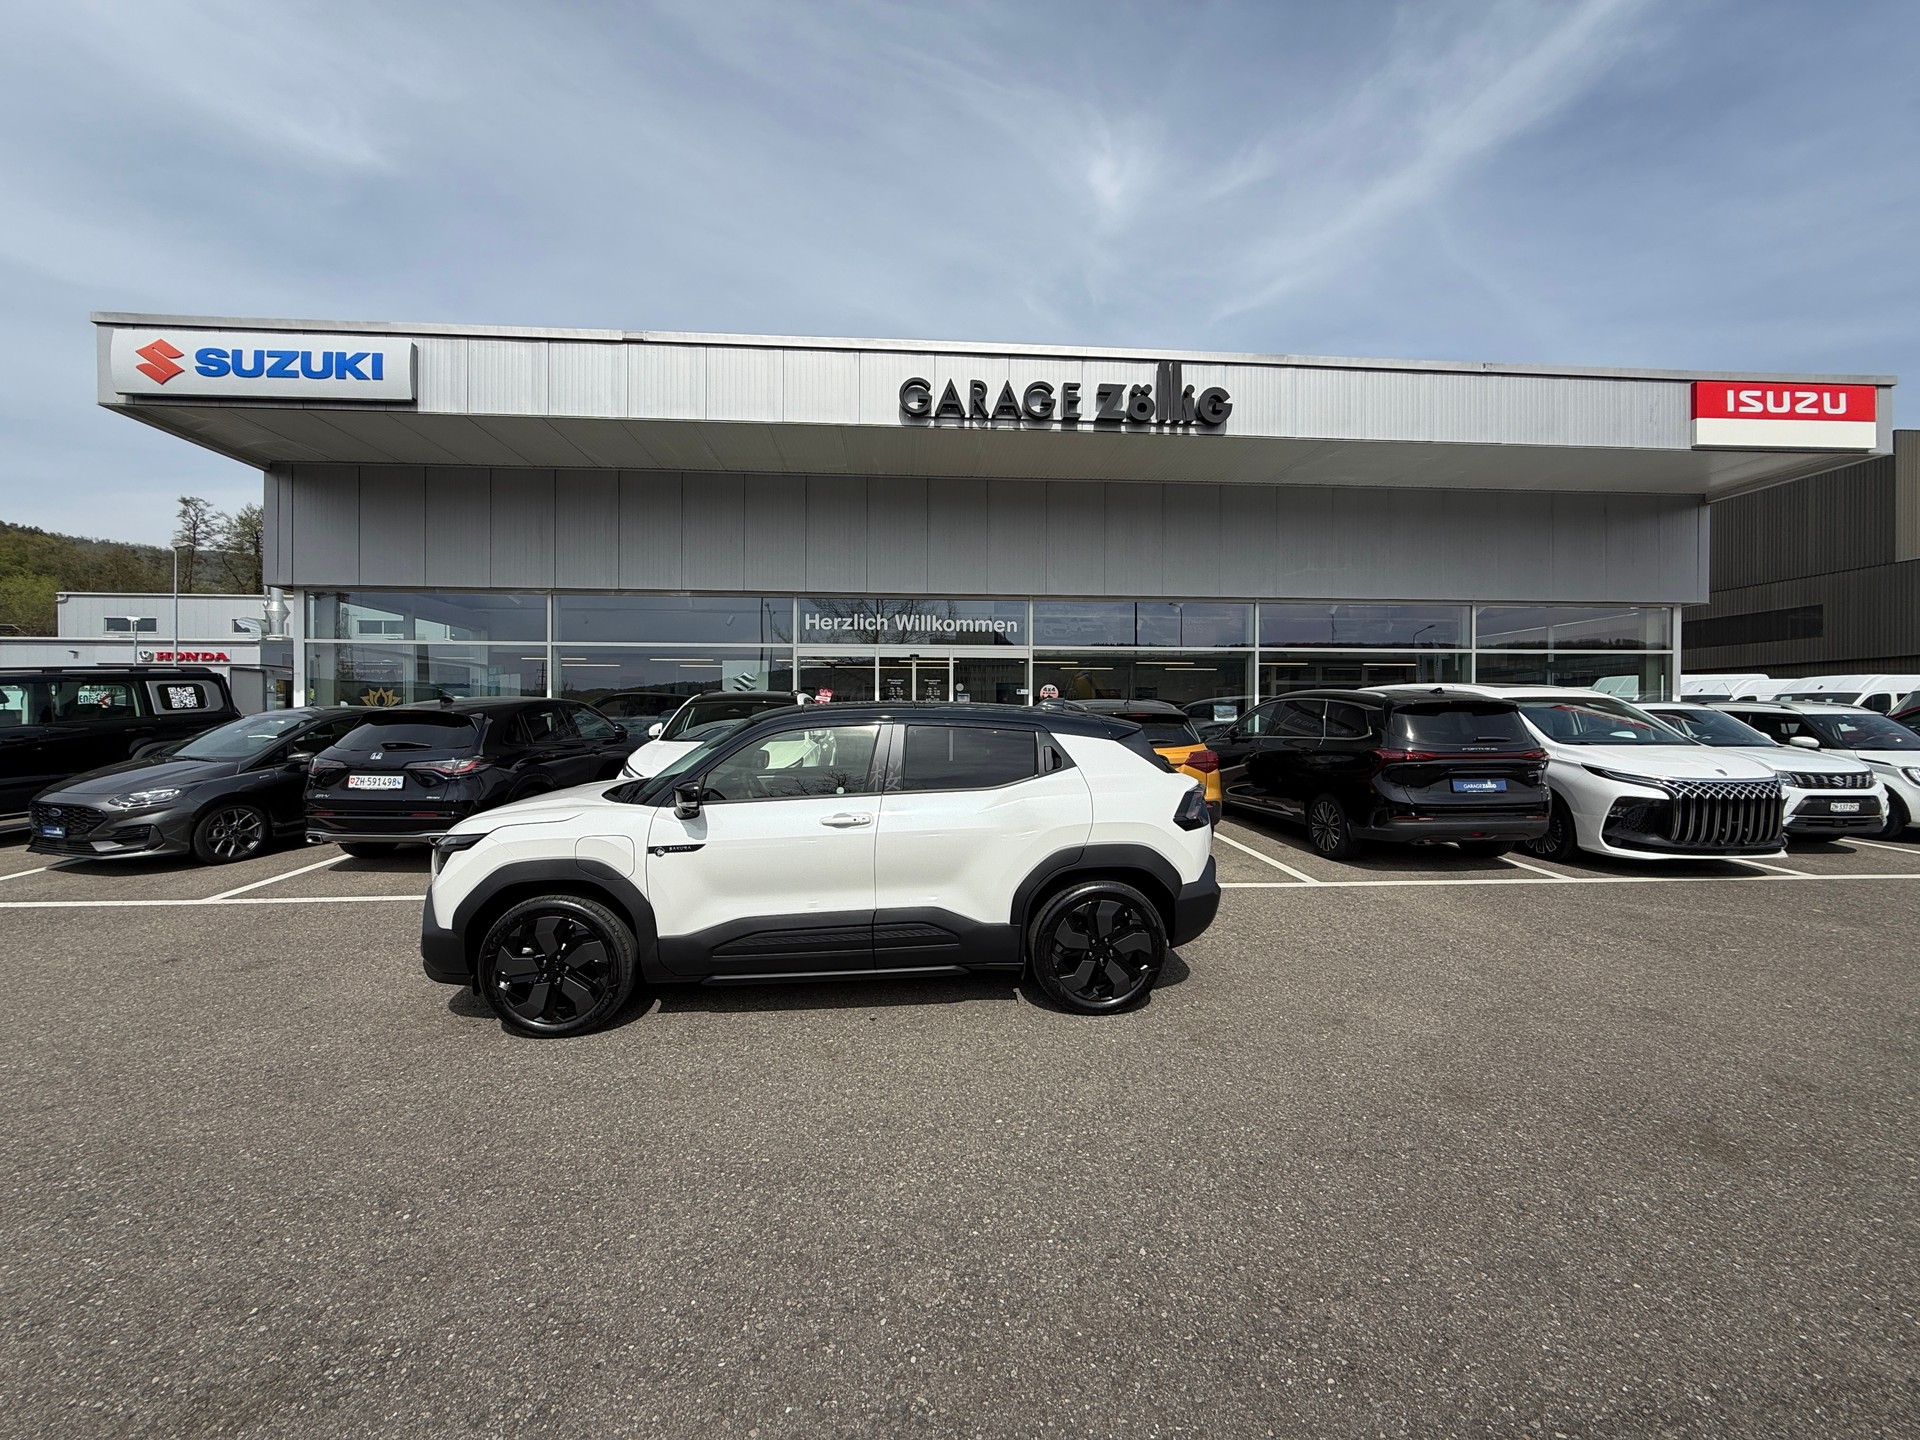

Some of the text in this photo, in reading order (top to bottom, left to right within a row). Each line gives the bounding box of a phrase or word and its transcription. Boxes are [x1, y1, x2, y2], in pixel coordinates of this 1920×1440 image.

[195, 347, 383, 381] SUZUKI
[899, 377, 1083, 421] GARAGE
[1726, 389, 1847, 415] ISUZU
[804, 613, 1018, 633] Herzlich Willkommen
[155, 651, 230, 662] HONDA
